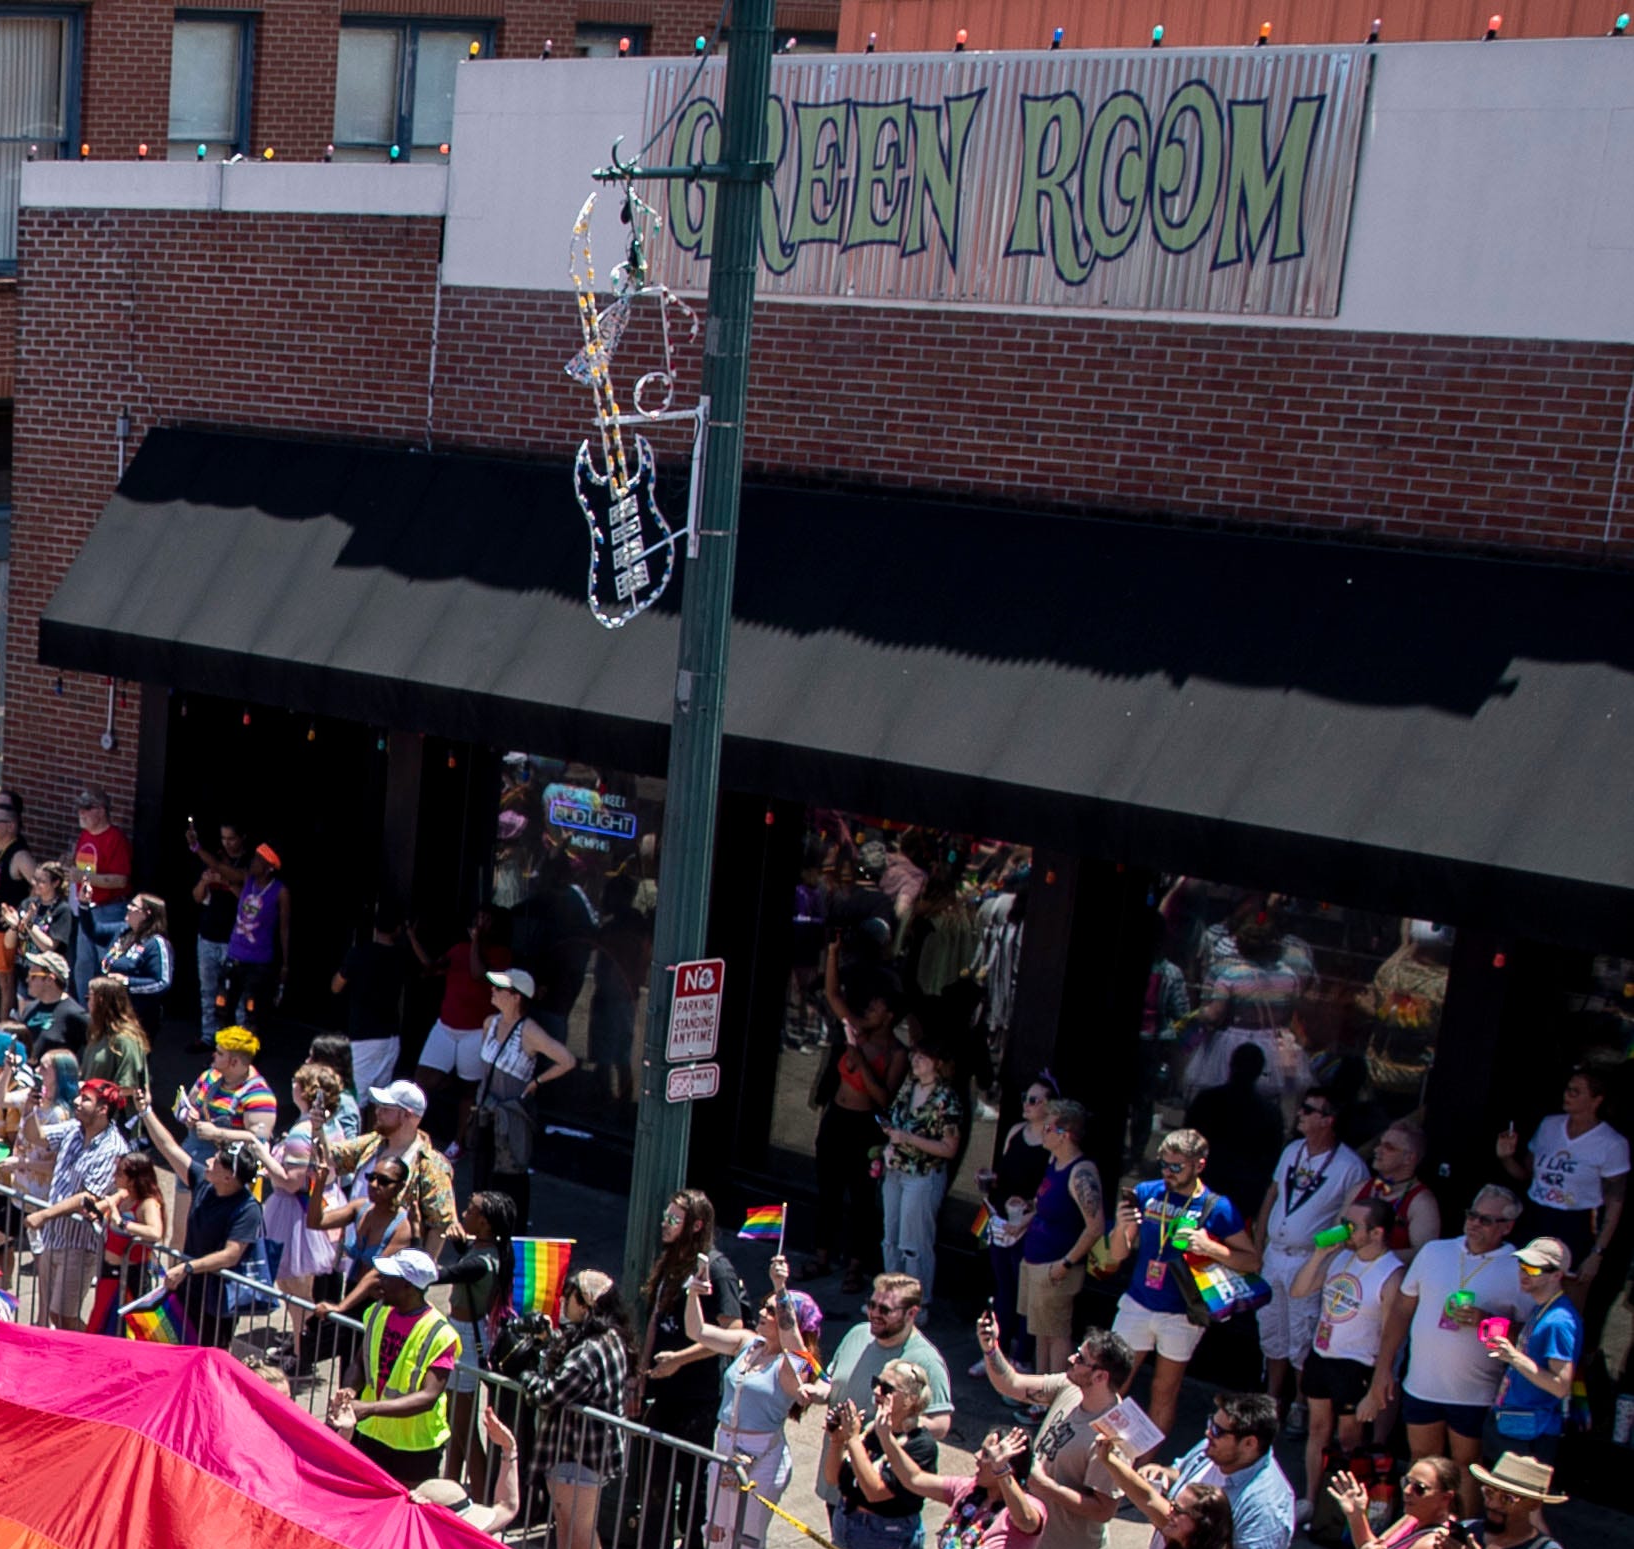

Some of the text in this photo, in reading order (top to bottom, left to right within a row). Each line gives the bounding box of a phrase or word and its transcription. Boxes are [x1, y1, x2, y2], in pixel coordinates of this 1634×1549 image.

[668, 79, 1326, 286] GREEN ROOM
[554, 805, 632, 832] BUD LIGHT
[676, 998, 714, 1015] PARKING
[674, 1017, 714, 1032] STANDING
[673, 1029, 712, 1044] ANYTIME
